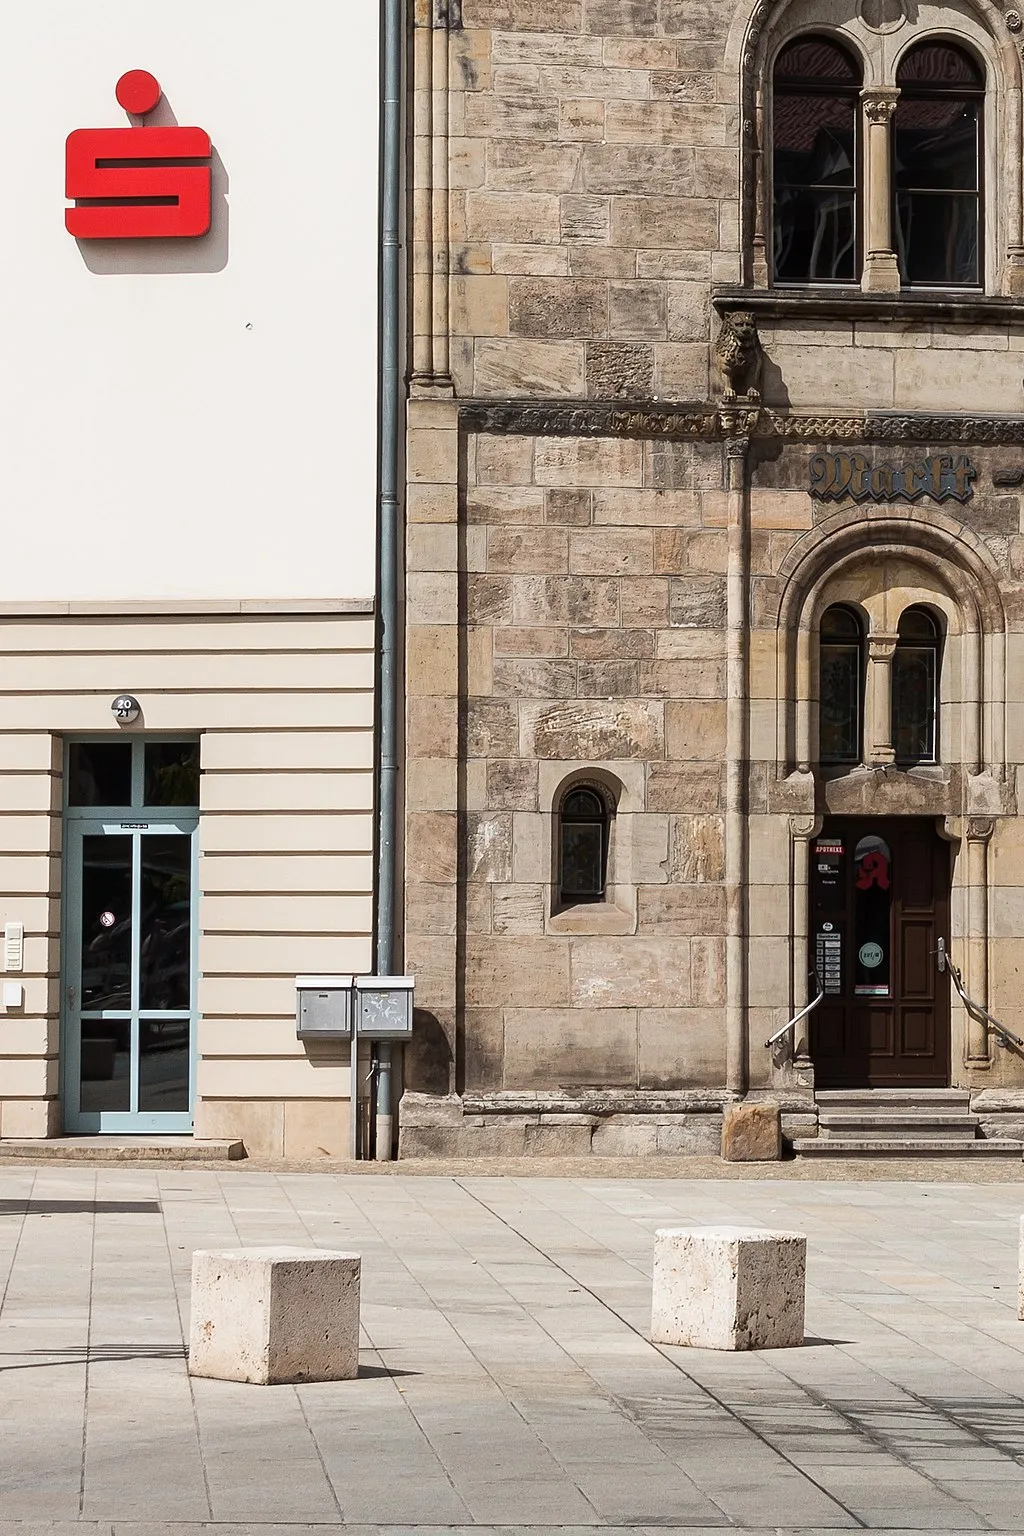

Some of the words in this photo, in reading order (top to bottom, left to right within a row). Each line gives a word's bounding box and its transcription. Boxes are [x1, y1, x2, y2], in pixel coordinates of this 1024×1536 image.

[809, 452, 976, 504] Markt
[117, 699, 132, 709] 20
[117, 709, 129, 717] 21
